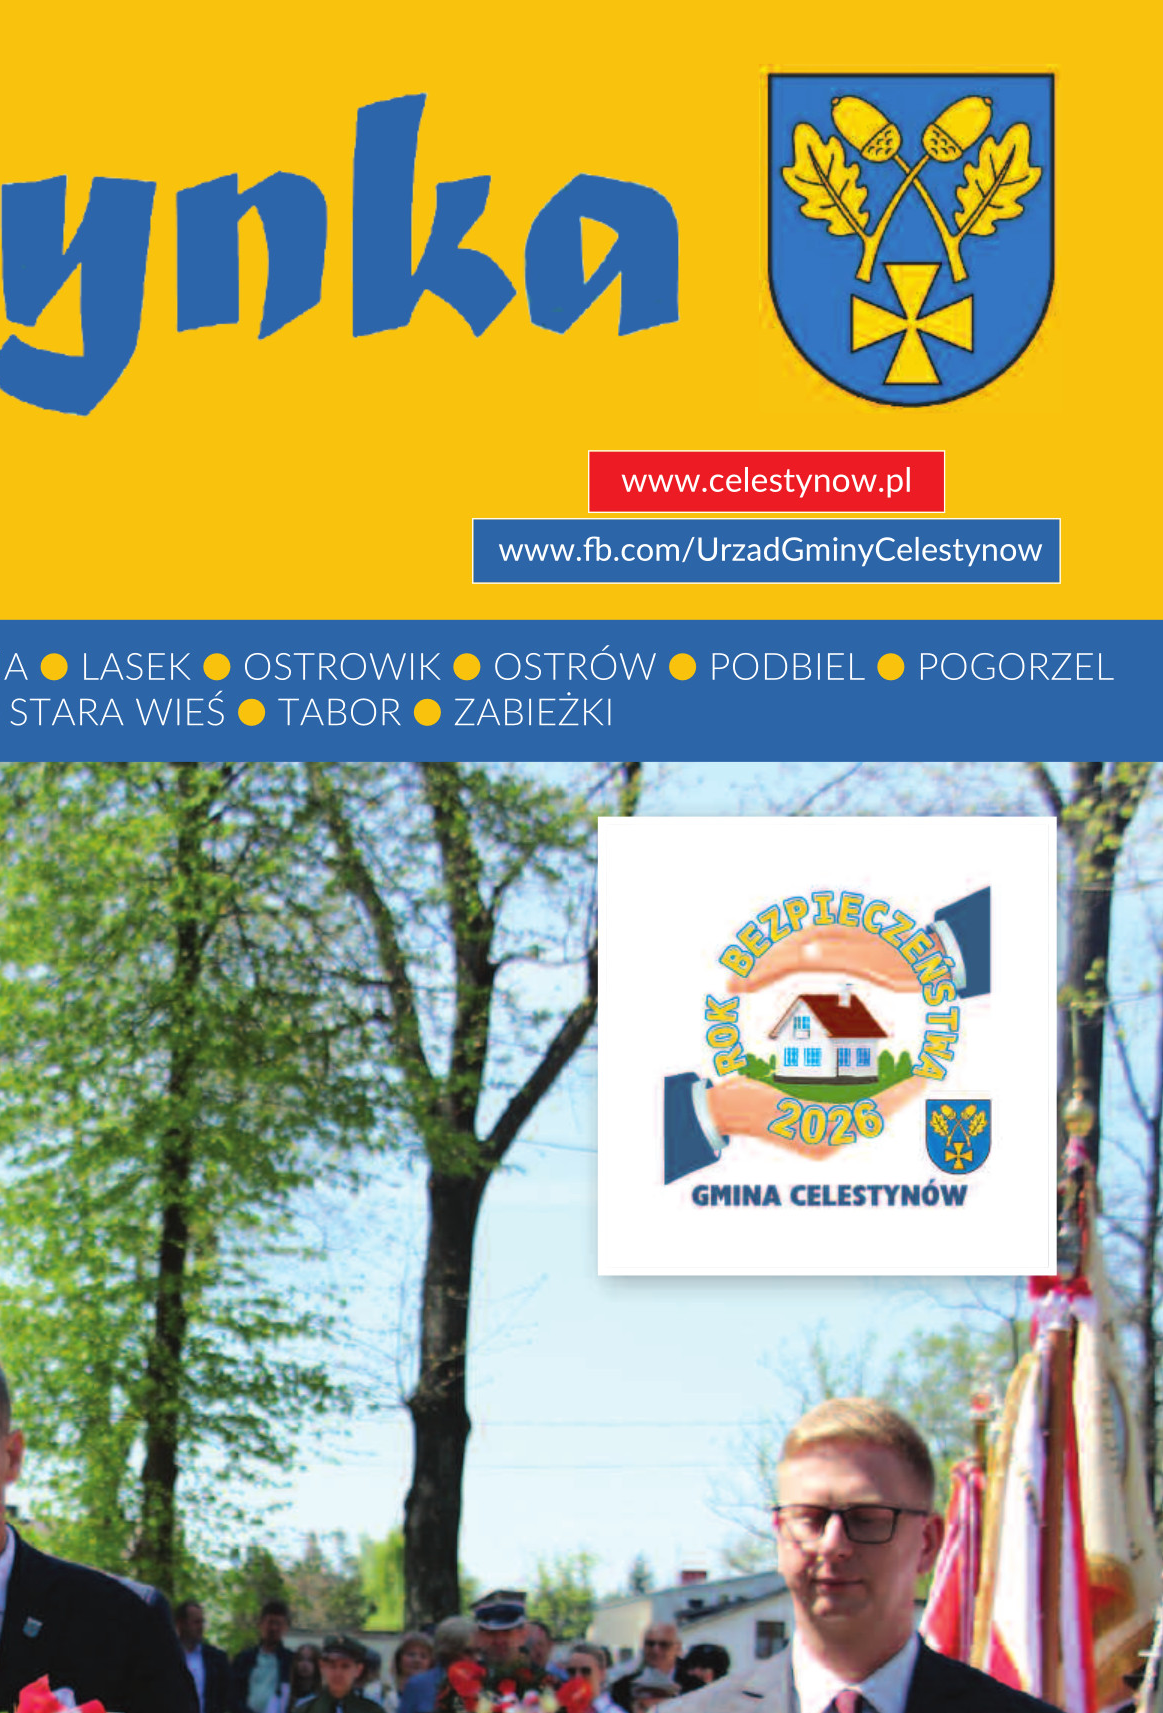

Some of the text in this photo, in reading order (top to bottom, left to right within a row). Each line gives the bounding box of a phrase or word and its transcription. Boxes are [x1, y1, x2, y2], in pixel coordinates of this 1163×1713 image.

[621, 466, 911, 500] www.celestynow.pl
[498, 535, 1043, 569] www.fb.com/UrzadGminyCelestynow
[83, 652, 191, 681] LASEK
[244, 652, 442, 681] OSTROWIK
[494, 644, 657, 681] OSTRÓW
[711, 652, 866, 681] PODBIEL
[920, 652, 1115, 681] POGORZEL
[10, 697, 124, 727] STARA
[135, 688, 225, 727] WIEŚ
[277, 697, 402, 727] TABOR
[454, 690, 612, 727] ZABIEŻKI
[705, 890, 960, 1081] ROK BEZPIECZEŃSTWA
[767, 1097, 884, 1146] 2026
[691, 1178, 969, 1207] GMINA CELESTYNÓW
